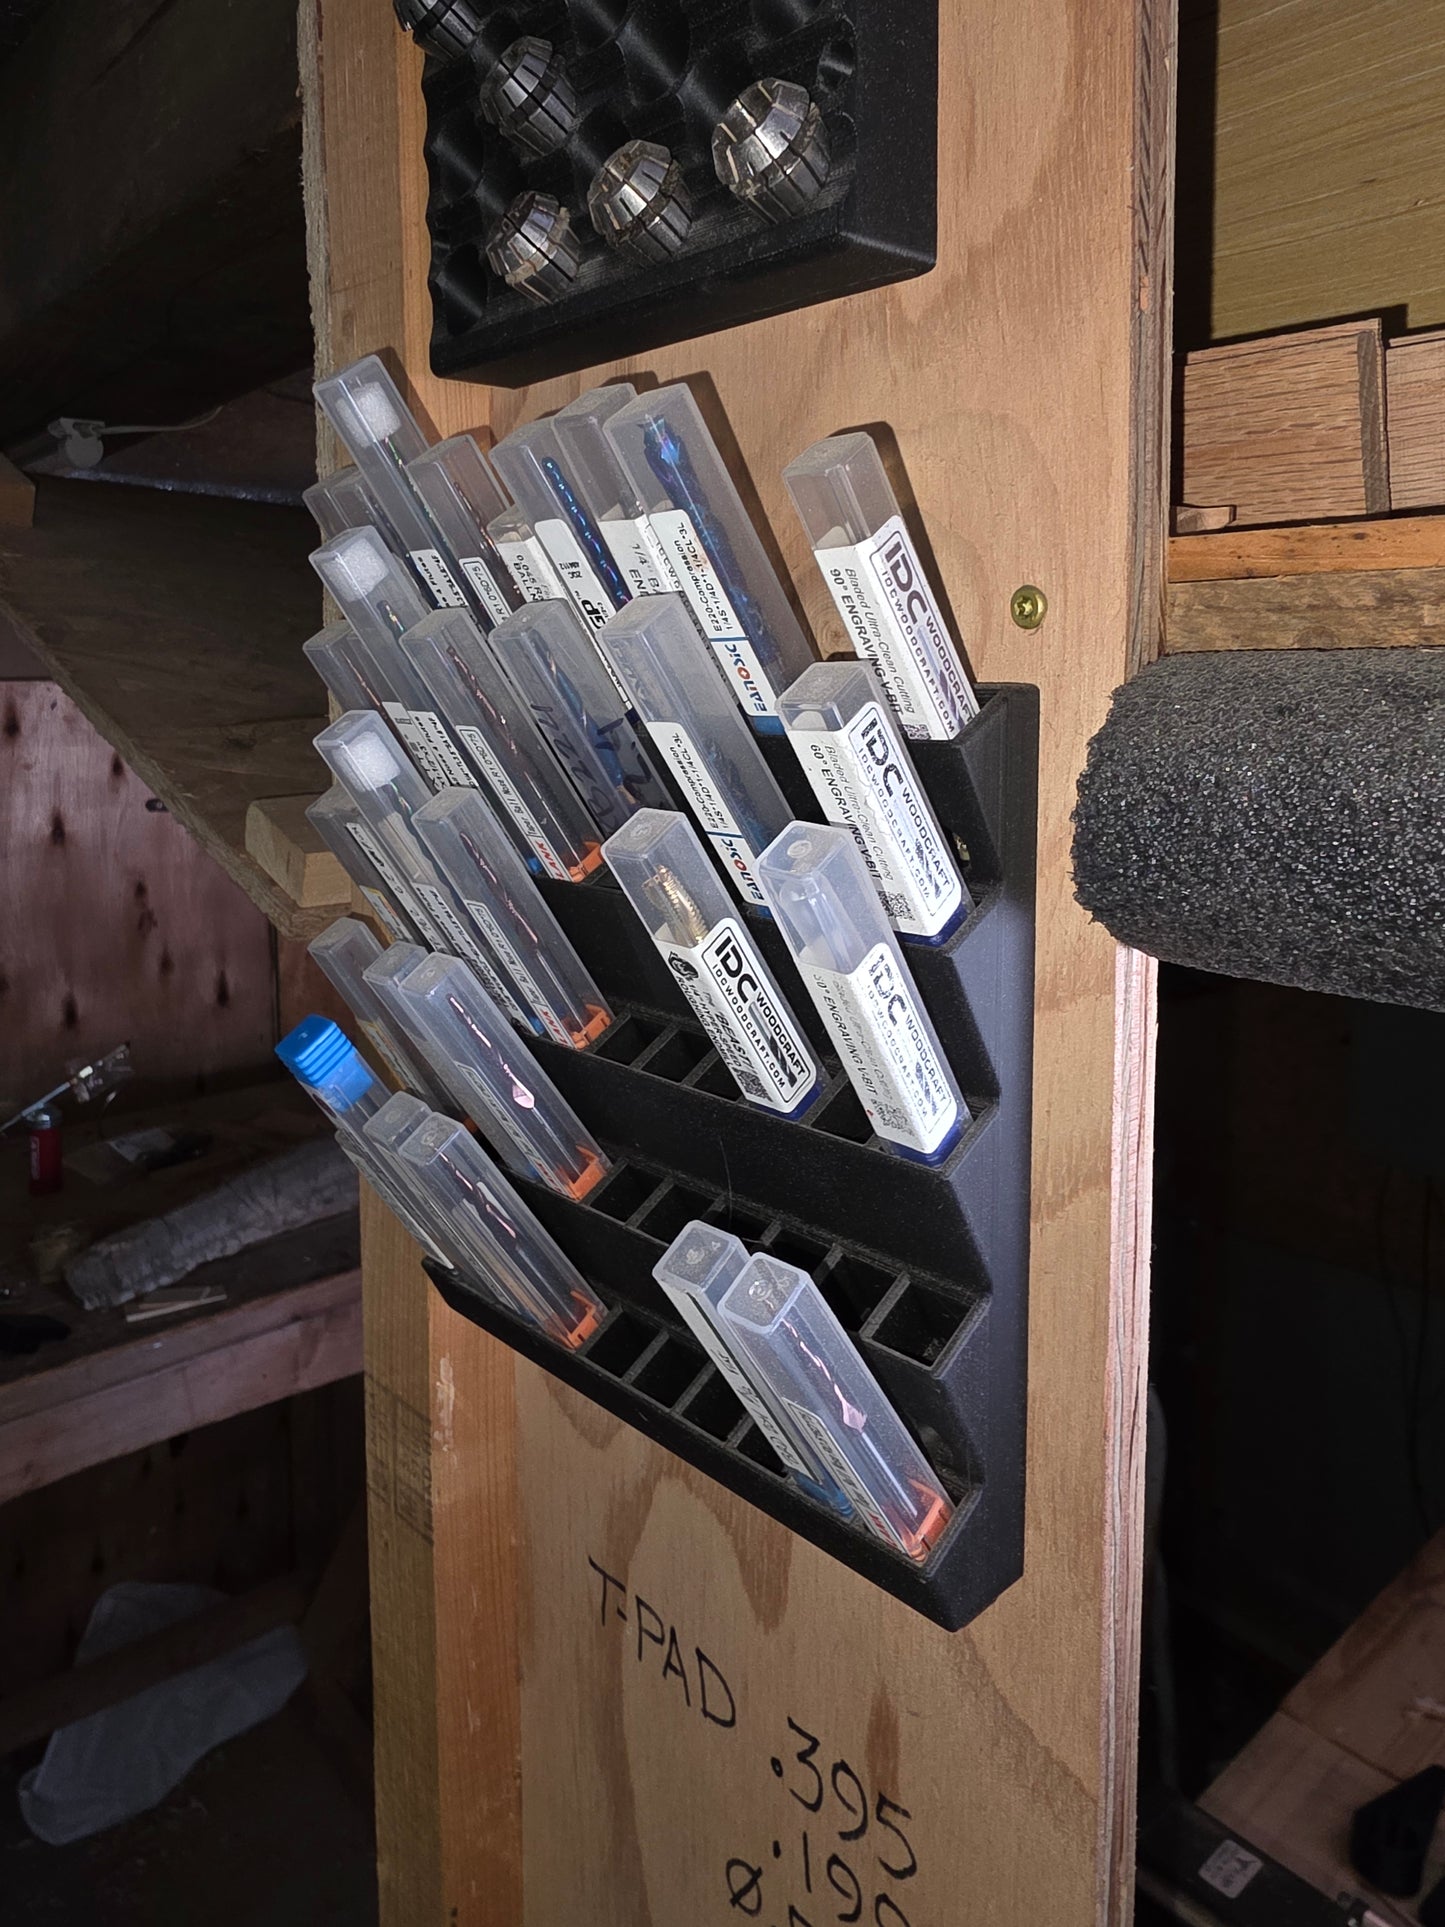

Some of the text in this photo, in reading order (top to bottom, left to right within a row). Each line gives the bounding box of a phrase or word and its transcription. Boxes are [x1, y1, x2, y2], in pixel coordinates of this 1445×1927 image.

[672, 539, 723, 632] E220-Compression
[828, 568, 848, 593] 90°
[840, 594, 891, 684] ENGRAVING
[843, 567, 917, 714] Bladed Ultra-Clean Cutting
[883, 541, 930, 625] IDC
[880, 569, 956, 733] IDCWOODCRAFT.COM
[807, 744, 883, 881] 60° ENGRAVING V-BIT
[823, 744, 895, 881] Bladed Ultra-Clean Cutting
[859, 718, 951, 887] IDC WOODCRAFT
[698, 1002, 742, 1067] HYPER-SPEED
[711, 963, 786, 1088] IDCWOODCRAFT.COM
[714, 936, 805, 1076] IDC WOODCRAFT
[822, 996, 864, 1066] ENGRAVING
[856, 1067, 877, 1095] V-BIT
[902, 1014, 948, 1101] WOODCRAFT
[588, 1555, 735, 1728] T-PAD
